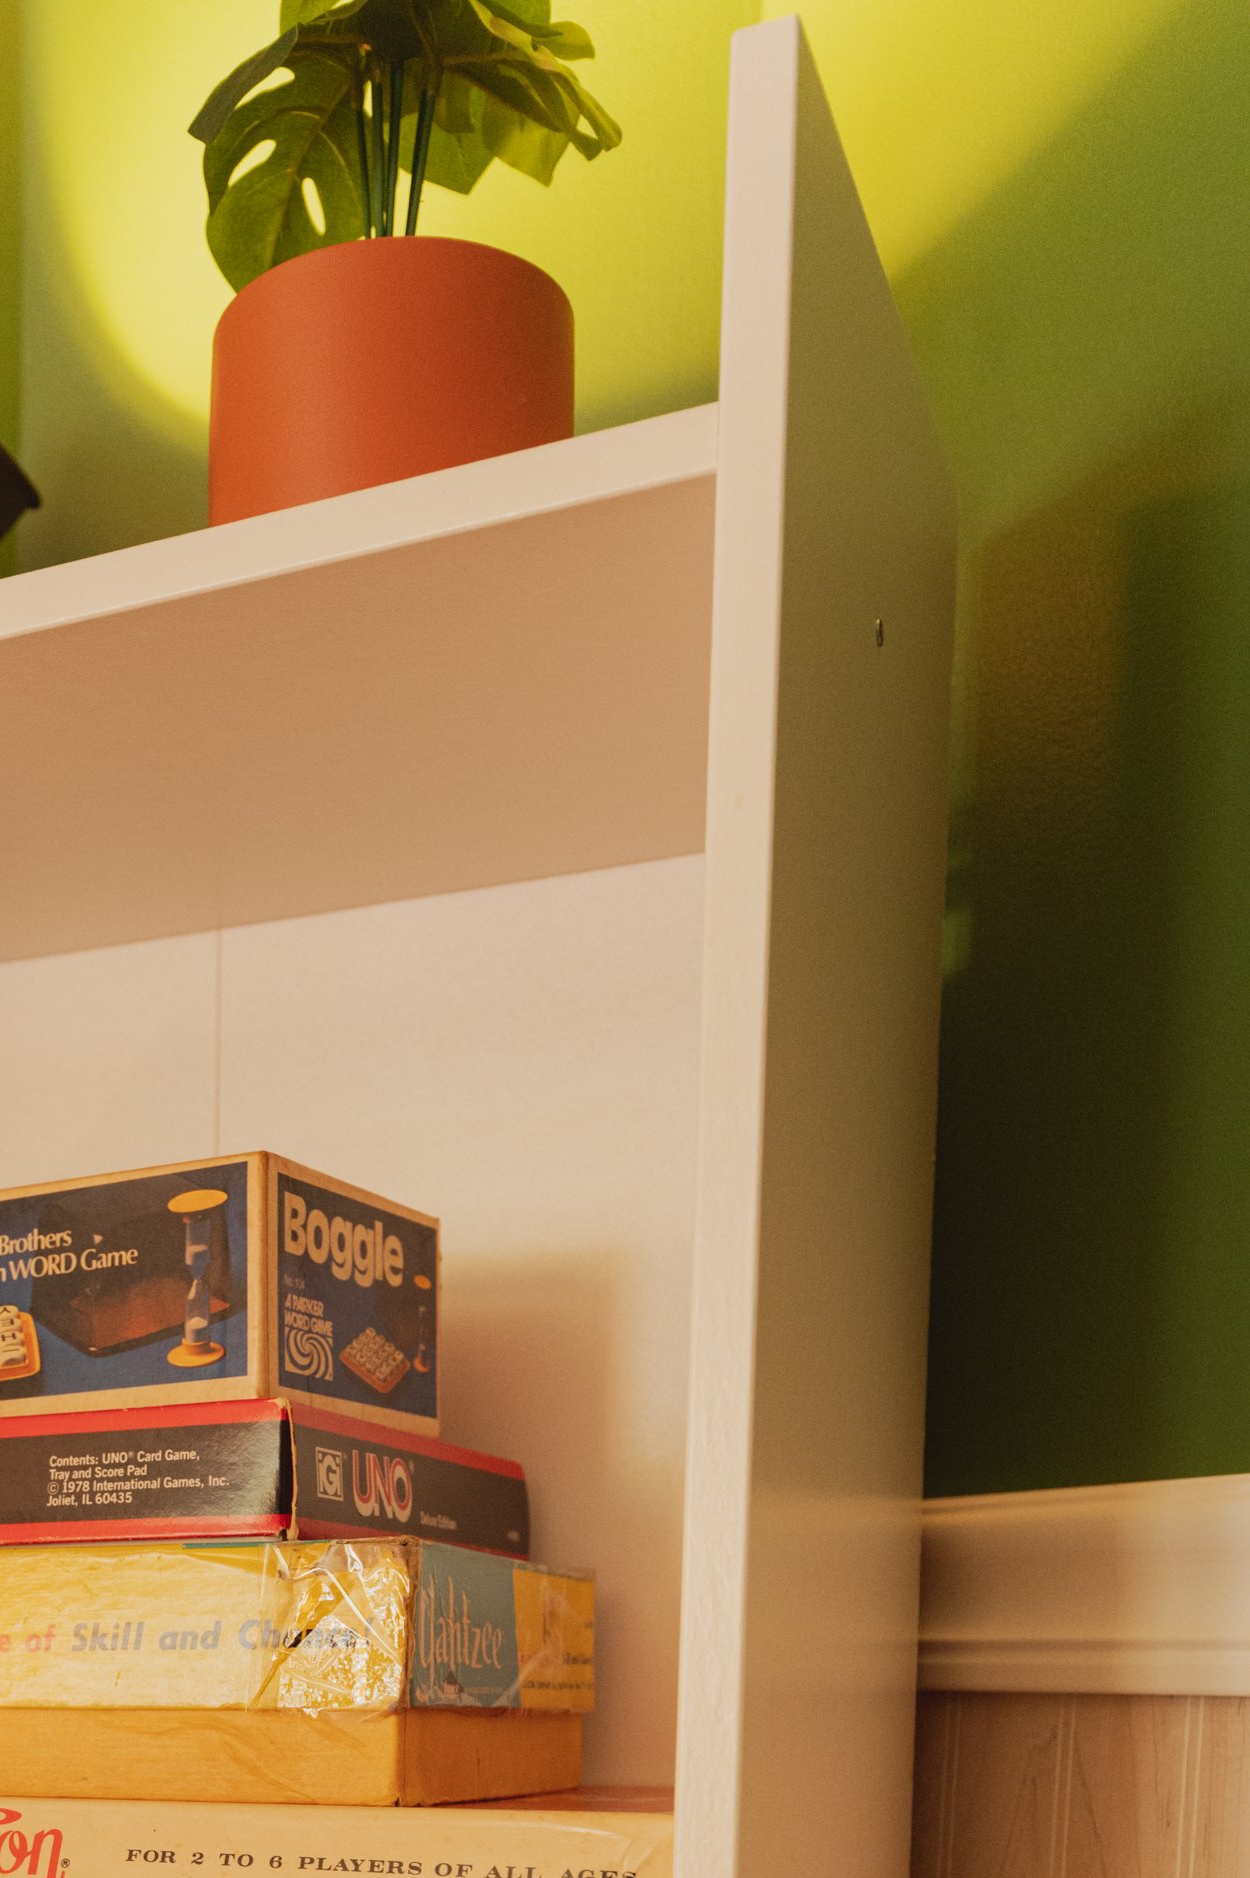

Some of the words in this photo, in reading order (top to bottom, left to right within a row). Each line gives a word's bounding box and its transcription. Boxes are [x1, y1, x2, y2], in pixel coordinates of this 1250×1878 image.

[284, 1190, 404, 1288] Boggle
[8, 1252, 77, 1280] WORD
[80, 1249, 139, 1272] Game
[285, 1293, 292, 1309] A
[292, 1294, 324, 1317] PARKER
[284, 1309, 310, 1331] WORD
[310, 1317, 333, 1336] GAME
[49, 1455, 99, 1467] Contents:
[136, 1450, 162, 1463] Card
[164, 1449, 200, 1462] Game,
[49, 1468, 70, 1481] Tray
[72, 1467, 92, 1479] and
[95, 1466, 124, 1478] Score
[127, 1464, 148, 1476] Pad
[62, 1480, 90, 1493] 1978
[93, 1477, 160, 1491] International
[163, 1476, 204, 1489] Games,
[208, 1474, 230, 1487] Inc.
[47, 1494, 78, 1507] Joliet,
[82, 1493, 93, 1505] IL
[95, 1492, 133, 1504] 60435
[25, 1624, 57, 1652] of
[71, 1621, 145, 1652] Skill
[158, 1621, 223, 1650] and
[125, 1848, 177, 1864] FOR
[191, 1851, 205, 1865] 2
[218, 1852, 254, 1868] TO
[268, 1854, 283, 1869] 6
[297, 1856, 422, 1876] PLAYERS
[434, 1861, 473, 1878] OF
